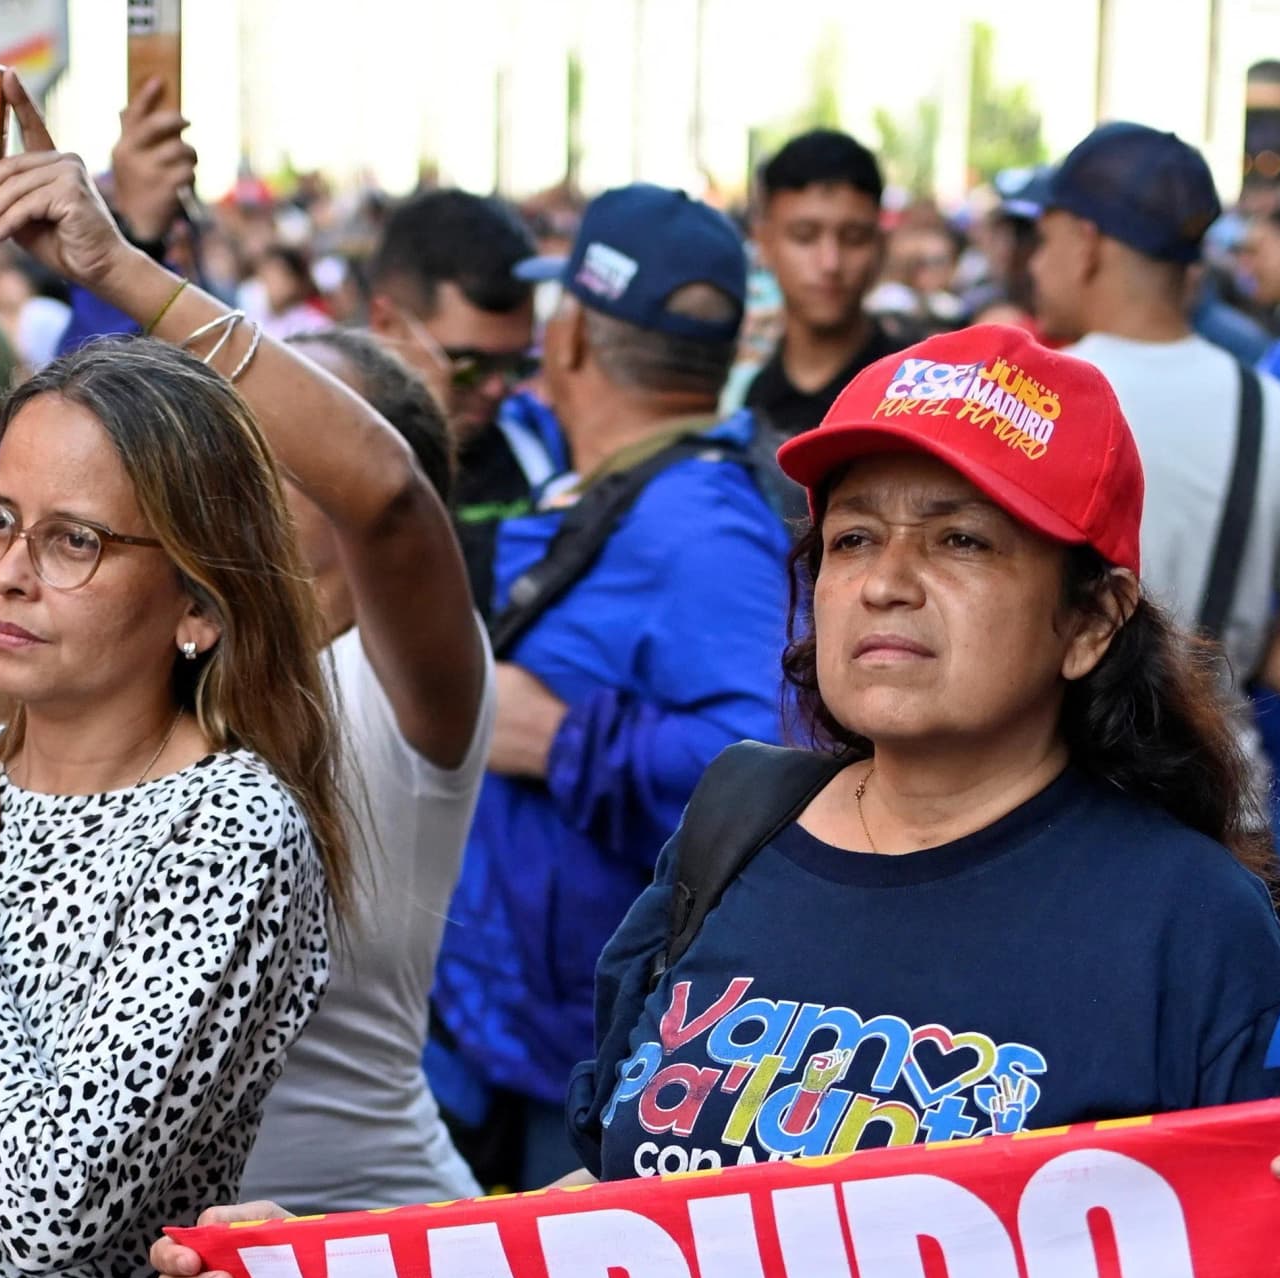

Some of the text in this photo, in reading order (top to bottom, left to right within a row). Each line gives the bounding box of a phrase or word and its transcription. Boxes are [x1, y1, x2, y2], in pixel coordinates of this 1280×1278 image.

[872, 397, 1048, 461] POR EL FUTURO
[884, 374, 1055, 445] CON MADURO
[601, 1040, 1032, 1158] pa'lant
[633, 1141, 722, 1178] con
